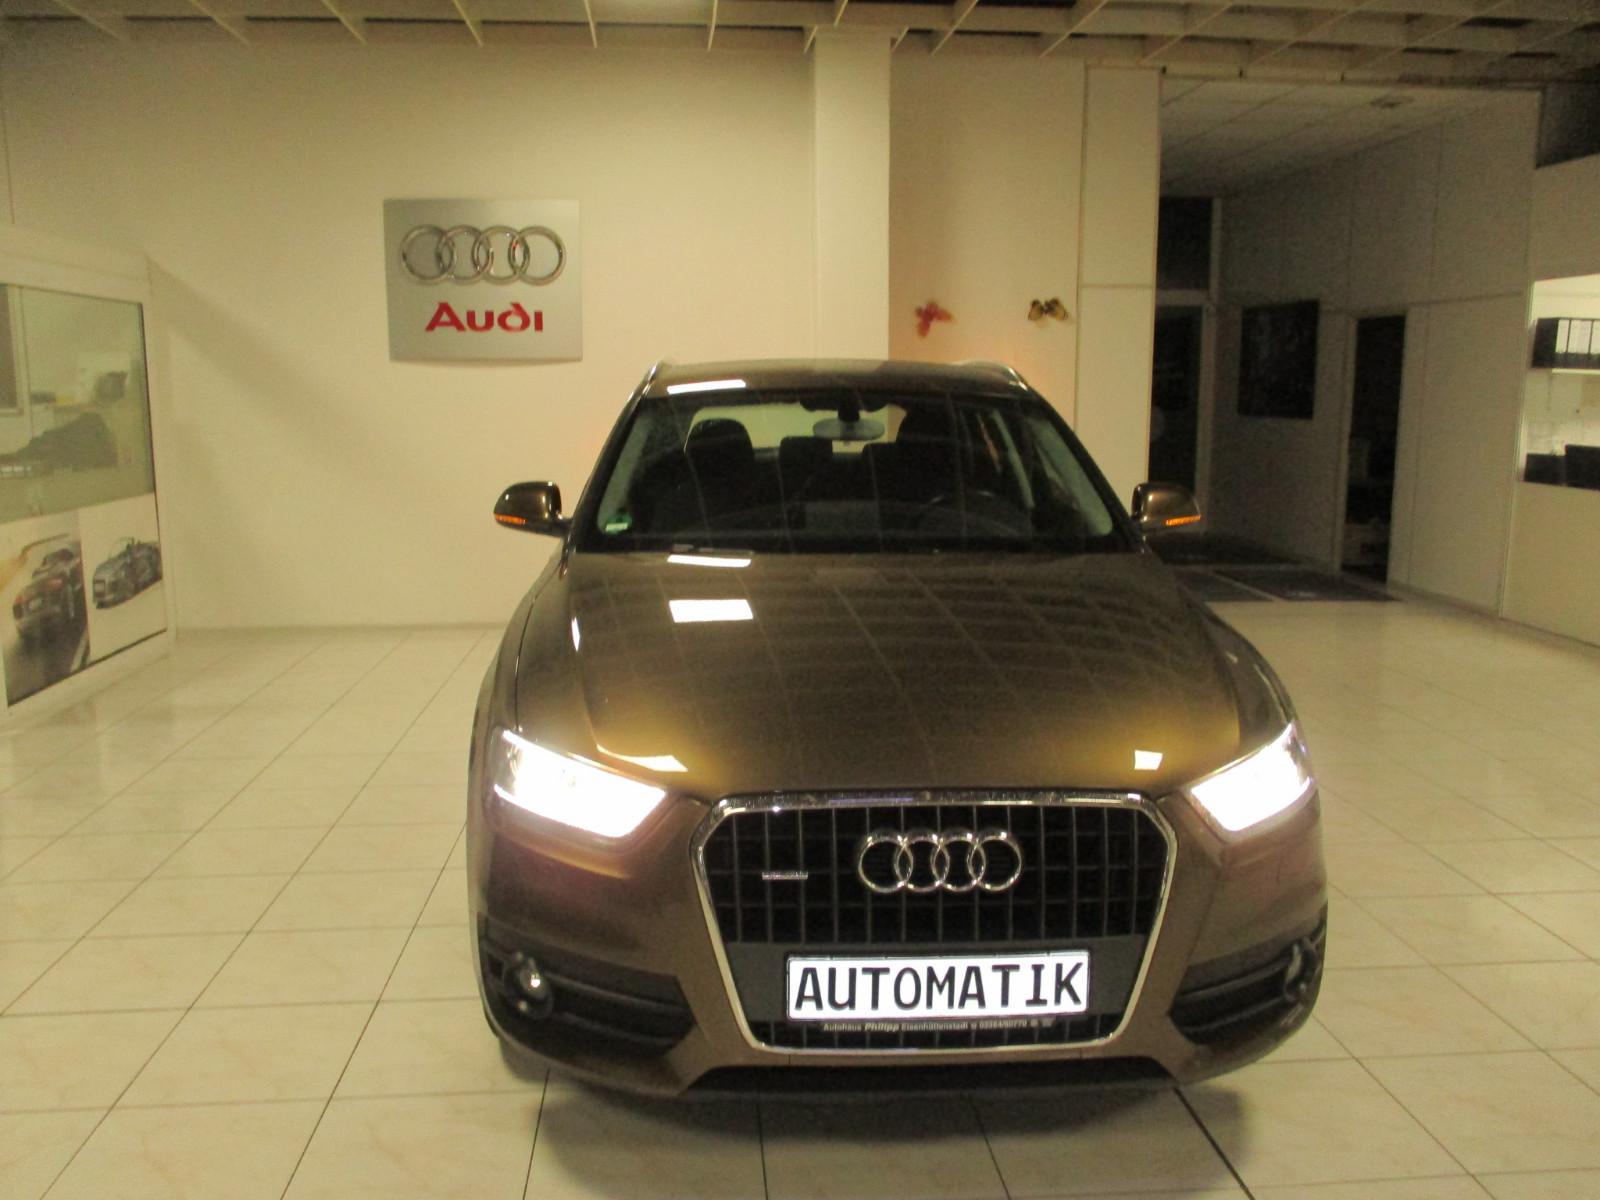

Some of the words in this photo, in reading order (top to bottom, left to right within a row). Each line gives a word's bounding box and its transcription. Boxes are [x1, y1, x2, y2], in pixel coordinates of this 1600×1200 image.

[424, 302, 543, 332] Audi
[795, 962, 1083, 1011] AUTOMATIK
[823, 1022, 862, 1032] Autohaus
[864, 1022, 900, 1034] Philipp
